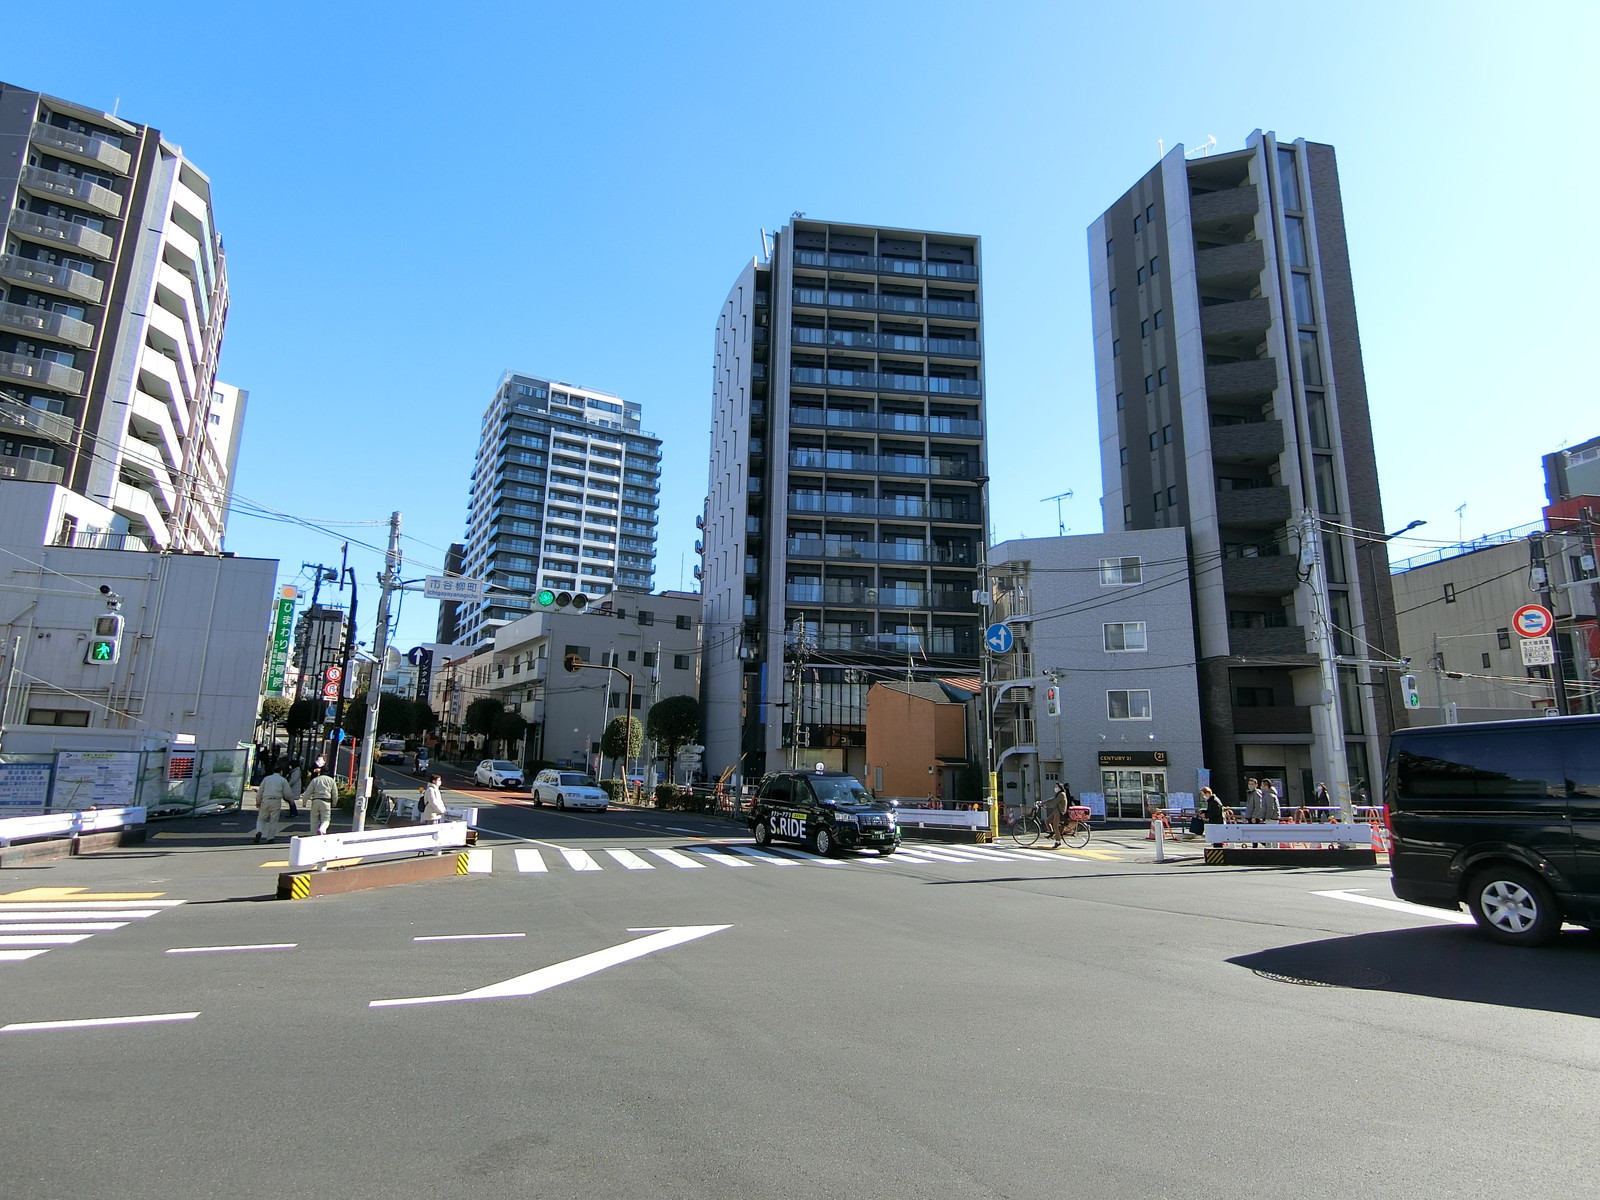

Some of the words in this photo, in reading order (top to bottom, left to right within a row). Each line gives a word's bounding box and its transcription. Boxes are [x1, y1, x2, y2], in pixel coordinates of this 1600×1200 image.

[430, 579, 478, 592] 市谷柳町
[426, 589, 478, 599] Ichigayayanagicho
[770, 816, 807, 839] S.RIDE
